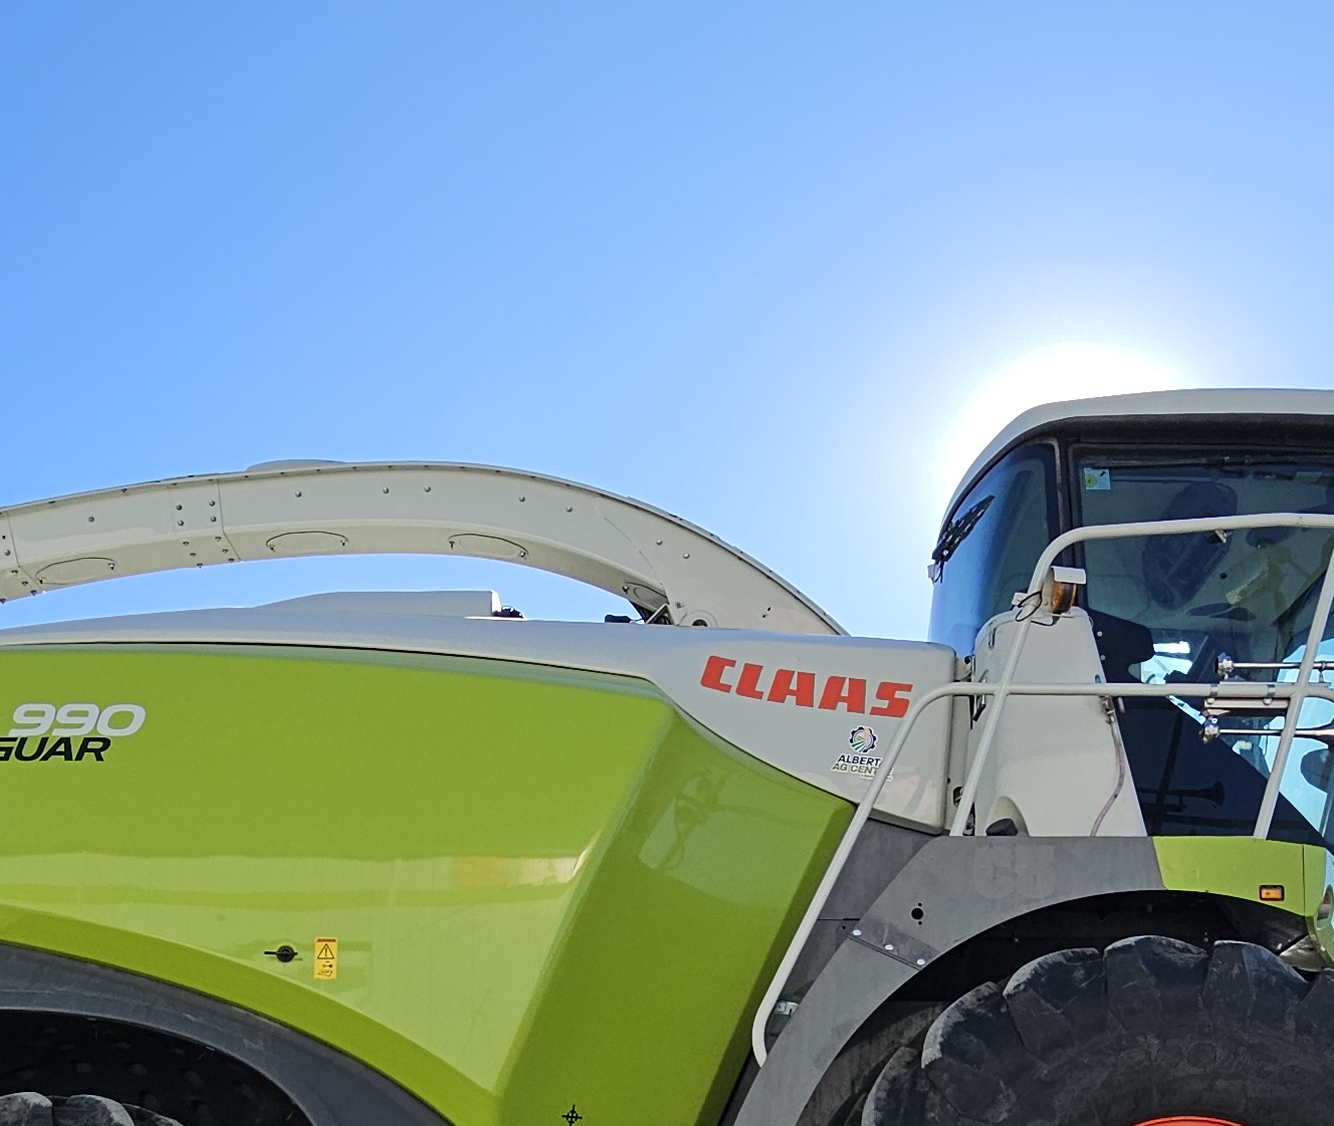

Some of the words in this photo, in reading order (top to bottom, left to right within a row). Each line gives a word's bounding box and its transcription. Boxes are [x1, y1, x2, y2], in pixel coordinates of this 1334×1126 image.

[700, 655, 913, 718] CLAAS
[8, 703, 146, 736] 990
[832, 763, 847, 771] AG
[851, 765, 878, 775] CENT
[837, 755, 881, 767] ALBERT
